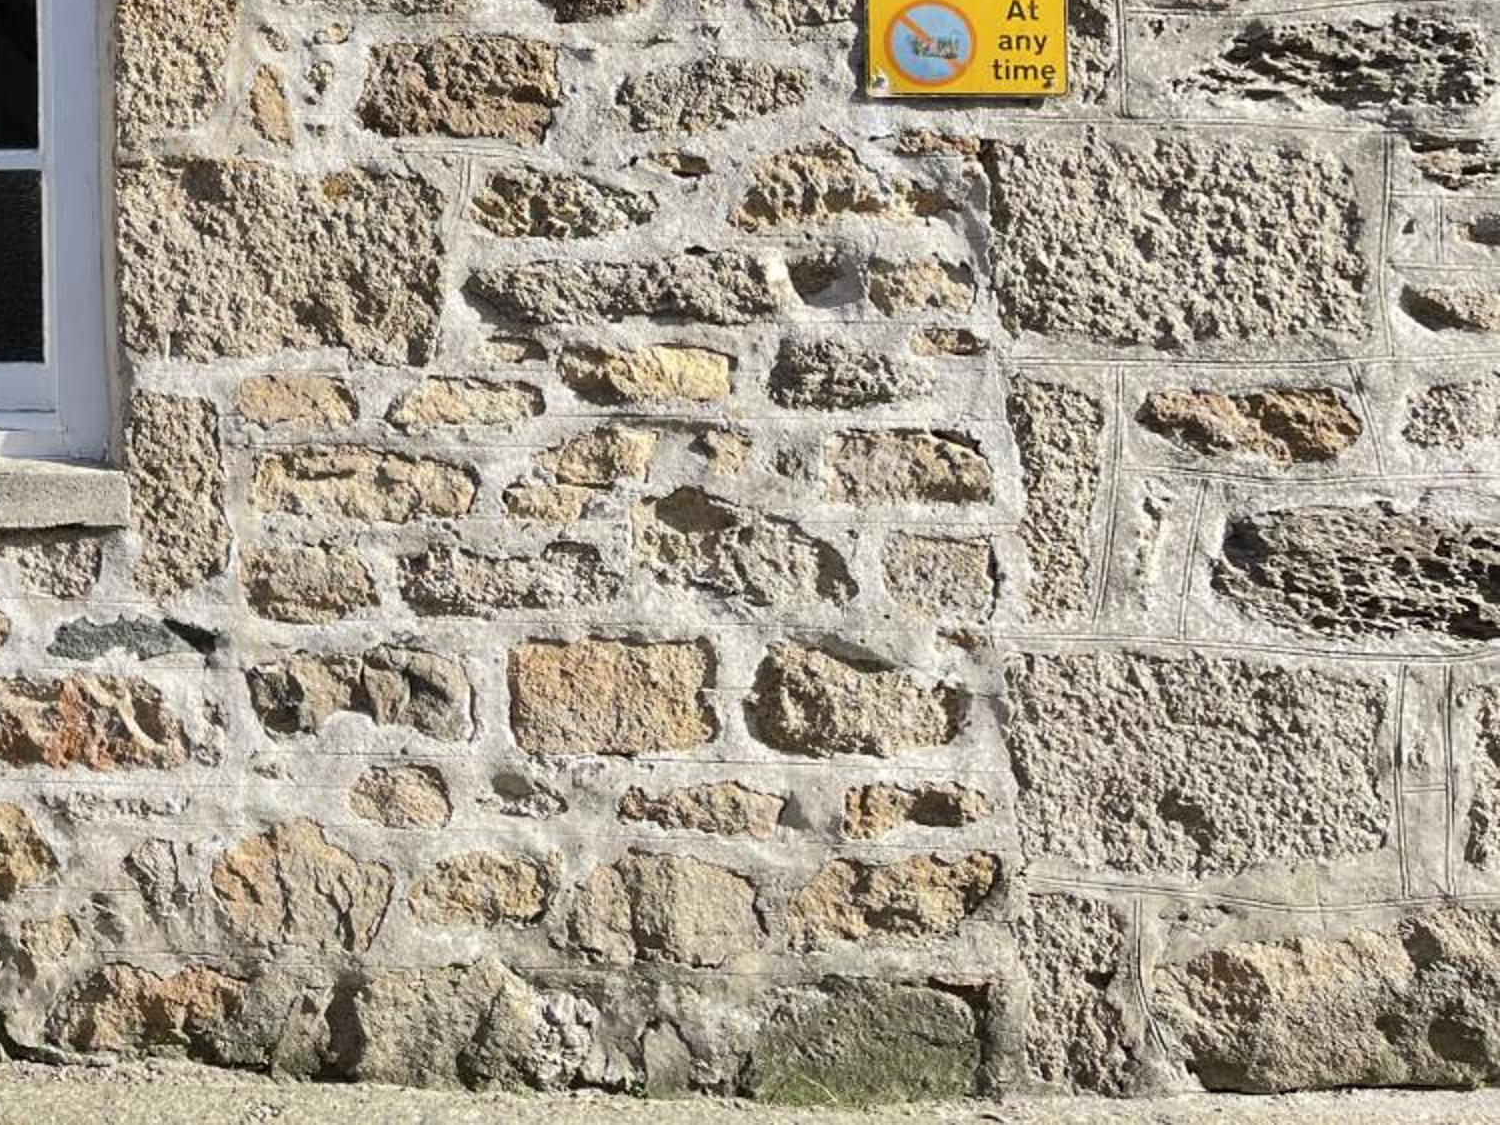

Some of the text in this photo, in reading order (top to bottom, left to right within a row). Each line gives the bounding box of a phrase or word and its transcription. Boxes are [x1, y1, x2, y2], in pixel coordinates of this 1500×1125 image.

[1006, 0, 1040, 21] At
[998, 34, 1048, 55] any
[992, 59, 1056, 81] time
